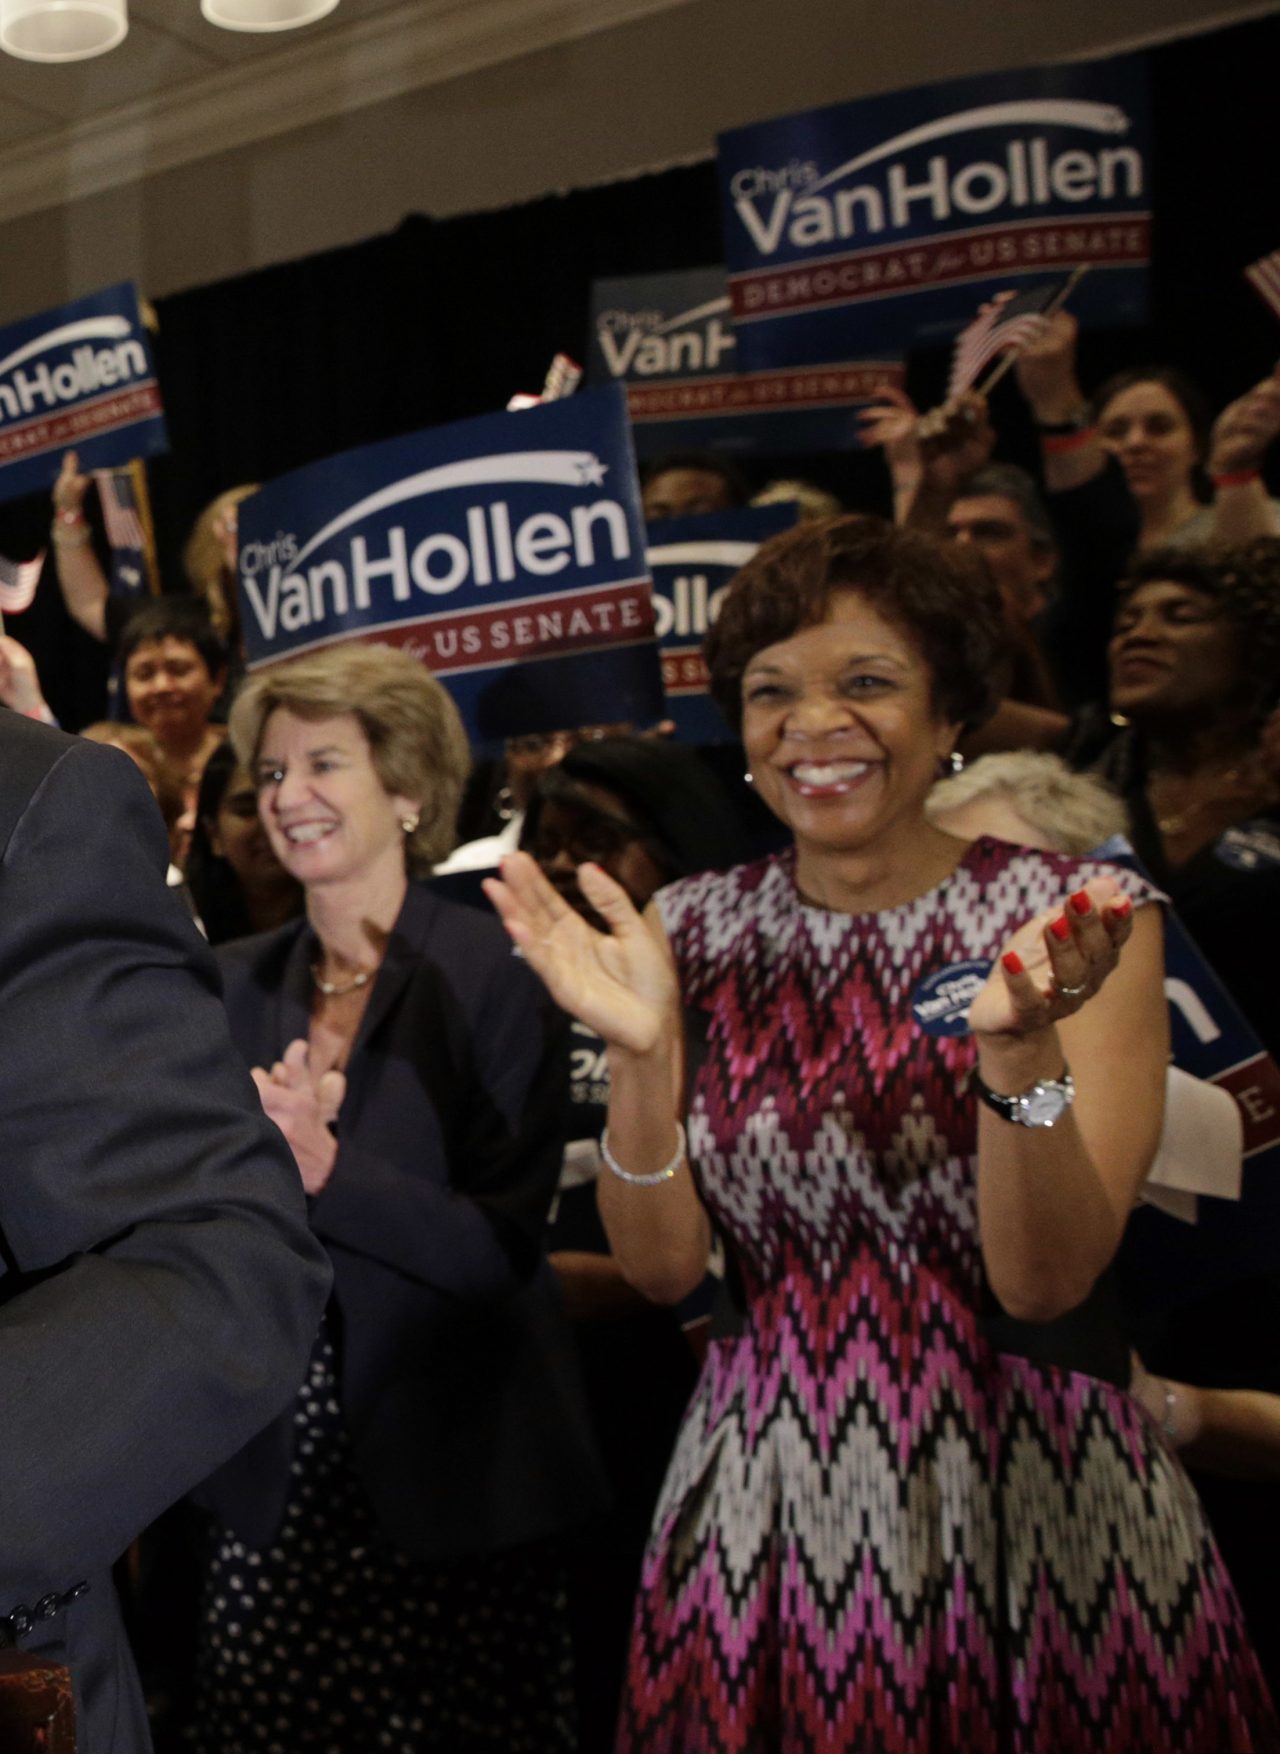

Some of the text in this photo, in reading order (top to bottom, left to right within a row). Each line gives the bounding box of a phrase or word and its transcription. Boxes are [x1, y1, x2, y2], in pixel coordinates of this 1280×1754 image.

[729, 159, 817, 200] Chris
[734, 138, 1143, 255] VanHollen
[741, 252, 929, 308] DEMOCRAT
[968, 235, 1022, 267] US
[1023, 227, 1143, 259] SENATE
[239, 530, 300, 577] Chris
[243, 499, 632, 640] VanHollen
[433, 625, 483, 658] US
[489, 601, 643, 650] SENATE
